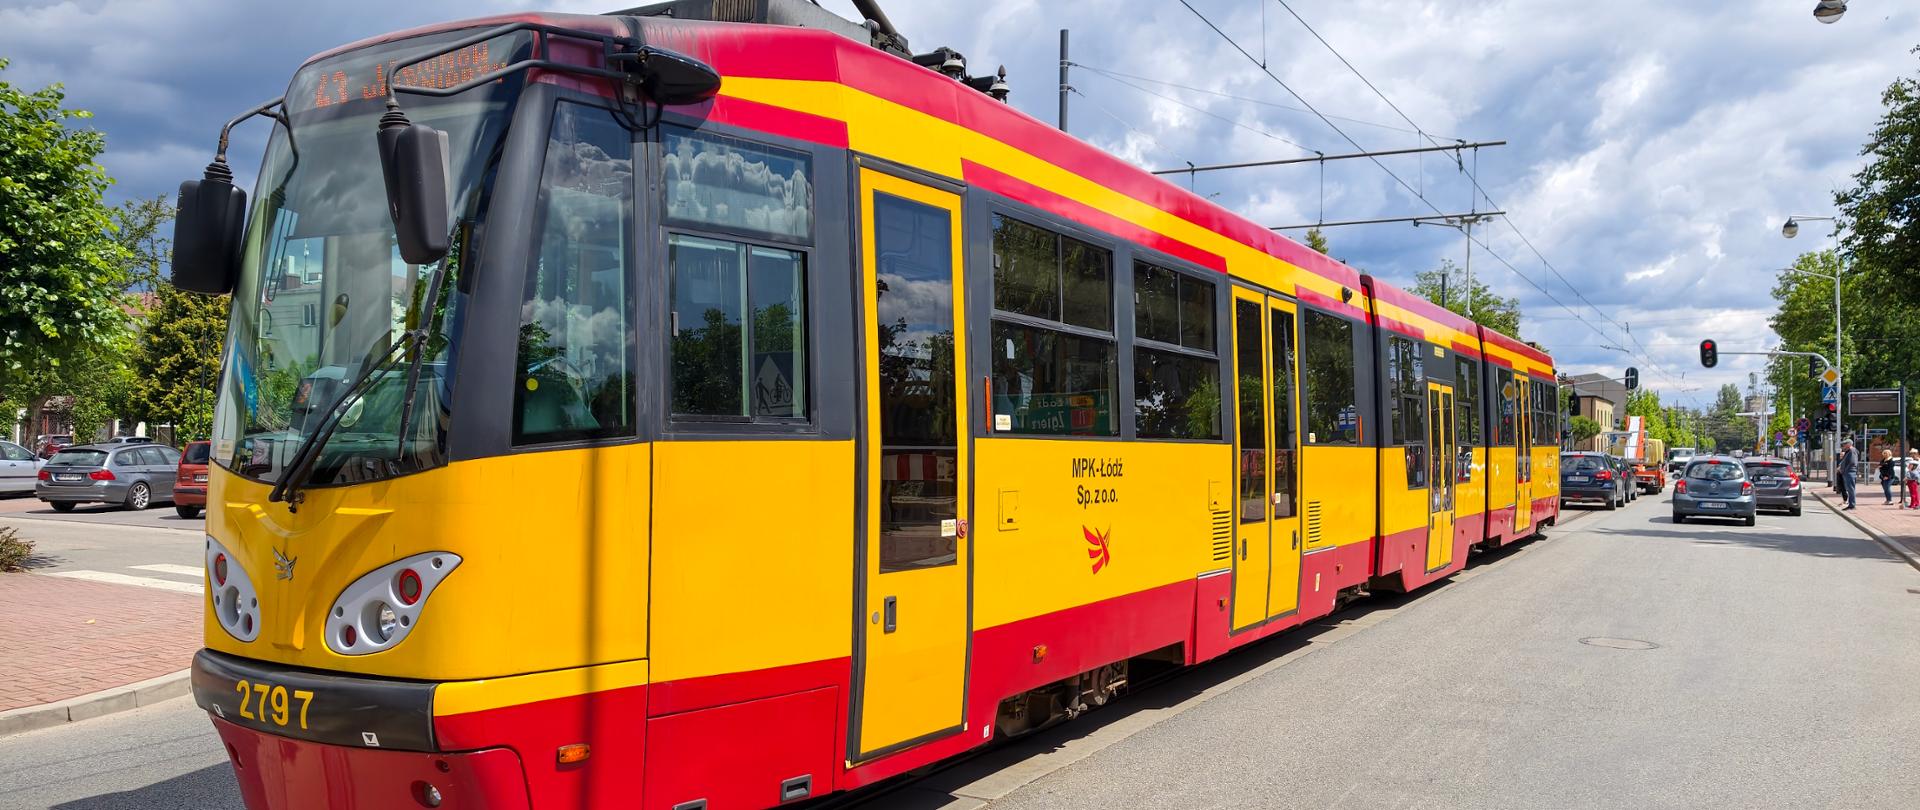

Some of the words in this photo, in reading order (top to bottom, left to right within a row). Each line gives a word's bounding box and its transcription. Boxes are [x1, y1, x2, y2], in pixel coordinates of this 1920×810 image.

[1072, 457, 1123, 478] MPK-Łódź
[1077, 484, 1093, 510] Sp.
[1094, 489, 1100, 504] z
[1101, 488, 1119, 503] o.o.
[236, 679, 314, 730] 2797
